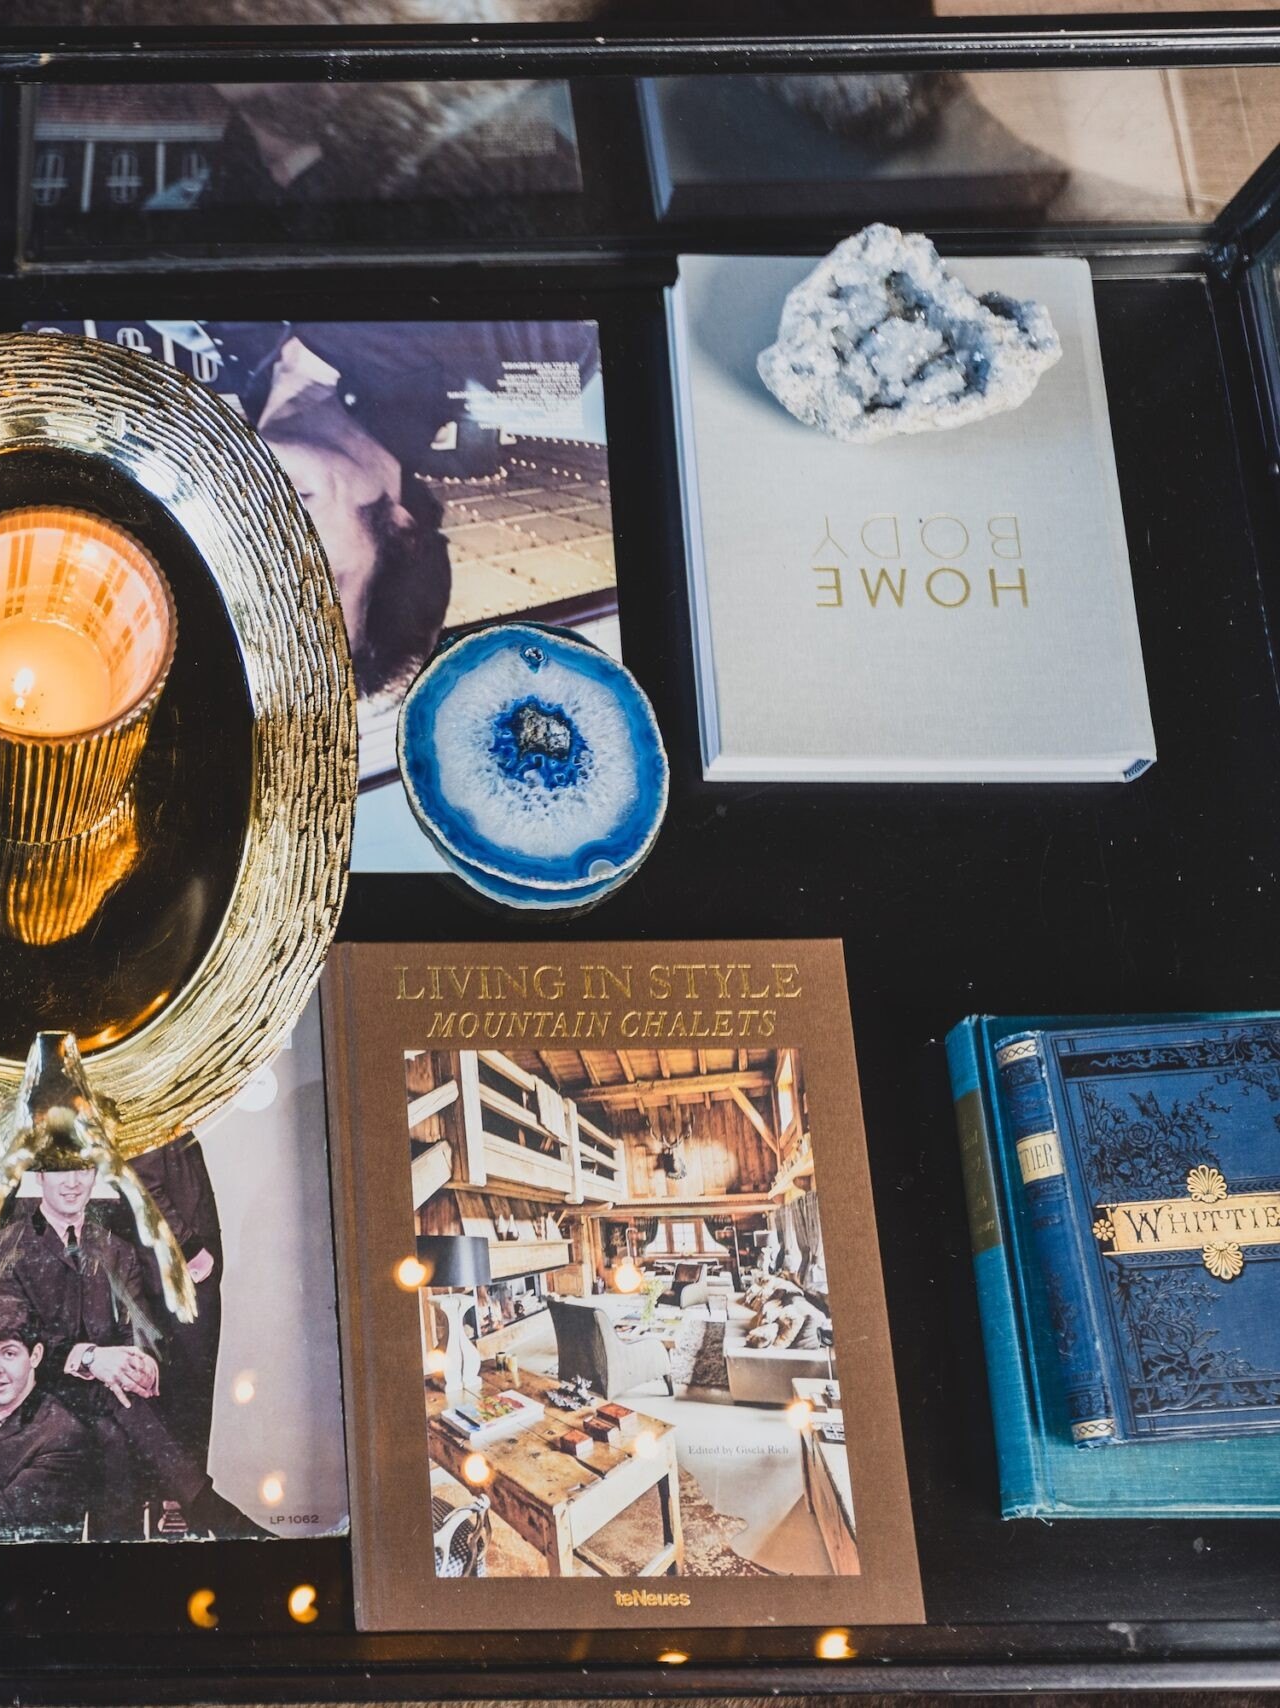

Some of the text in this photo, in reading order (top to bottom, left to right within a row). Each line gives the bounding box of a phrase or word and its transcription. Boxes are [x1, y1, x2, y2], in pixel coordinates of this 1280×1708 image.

[812, 513, 1022, 560] BODY
[812, 567, 1029, 608] HOME
[394, 963, 803, 1000] LIVING IN STYLE
[426, 1009, 777, 1039] MOUNTAIN CHALETS
[1017, 1142, 1055, 1175] TIER
[1122, 1203, 1280, 1243] WHITTIE
[687, 1444, 720, 1455] Edited
[722, 1444, 734, 1456] by
[269, 1514, 320, 1525] LP 1062
[614, 1588, 691, 1607] teNeues
